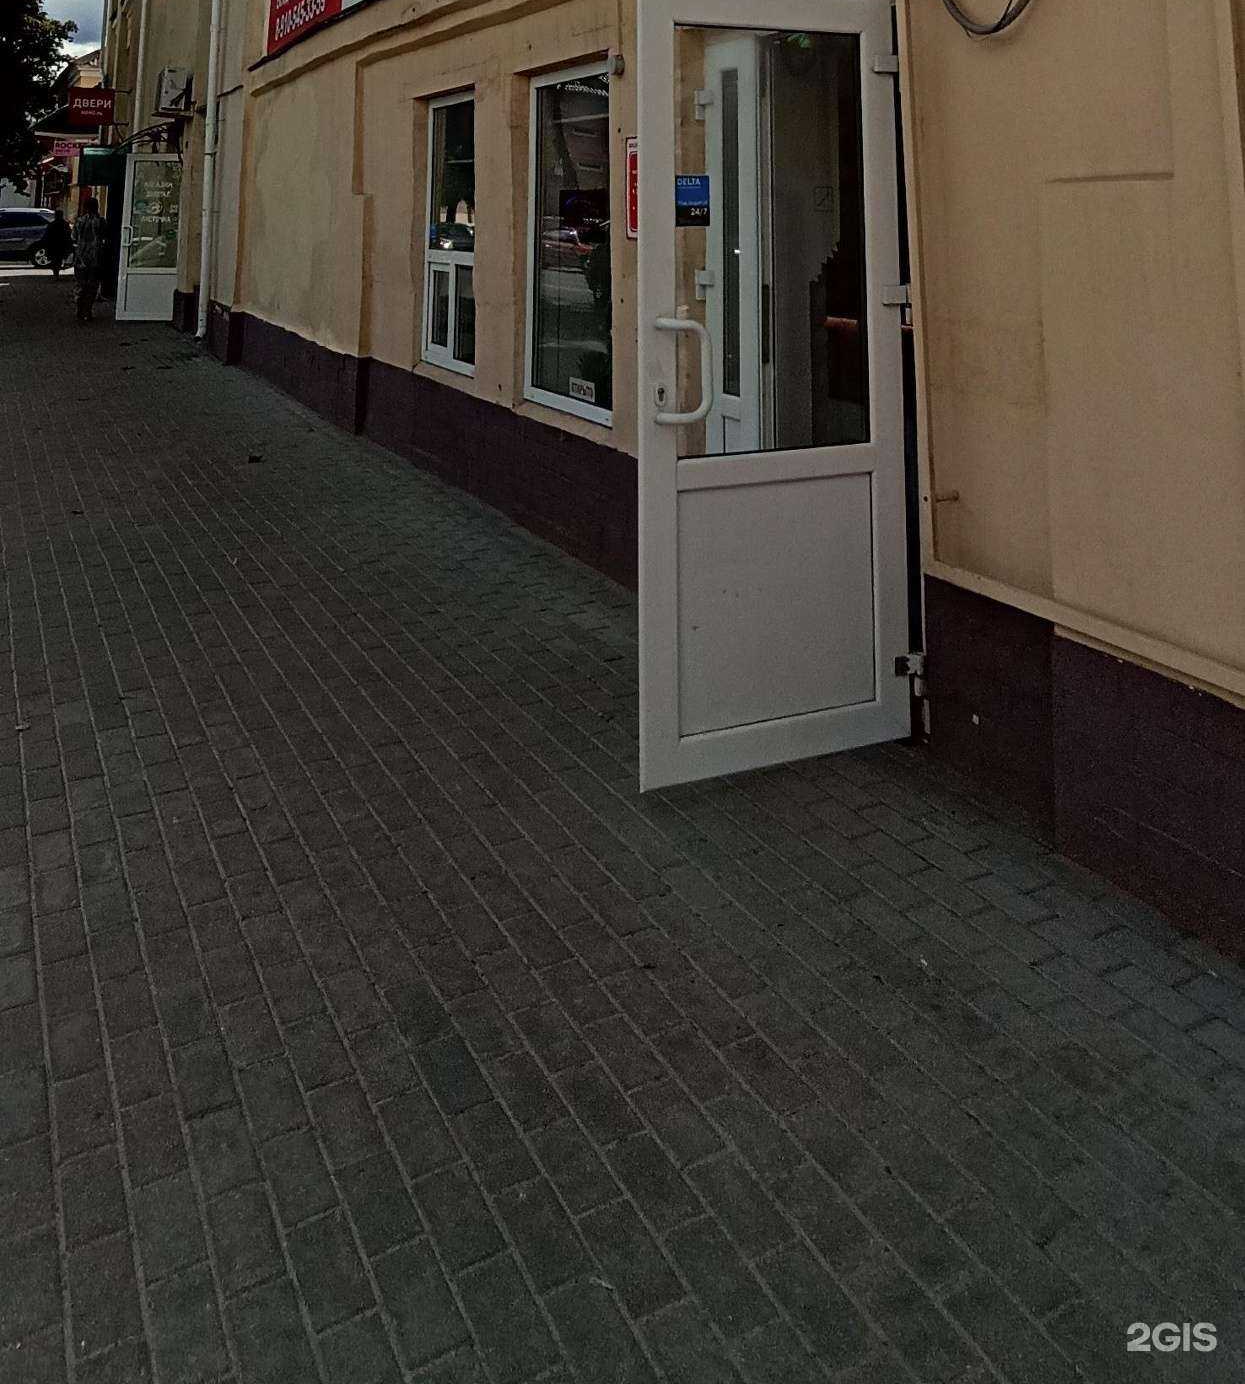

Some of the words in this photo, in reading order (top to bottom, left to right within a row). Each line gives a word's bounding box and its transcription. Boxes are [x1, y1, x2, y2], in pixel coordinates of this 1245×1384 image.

[72, 98, 112, 109] ДВЕРИ
[677, 178, 701, 186] DELTA
[690, 208, 708, 216] 24/7
